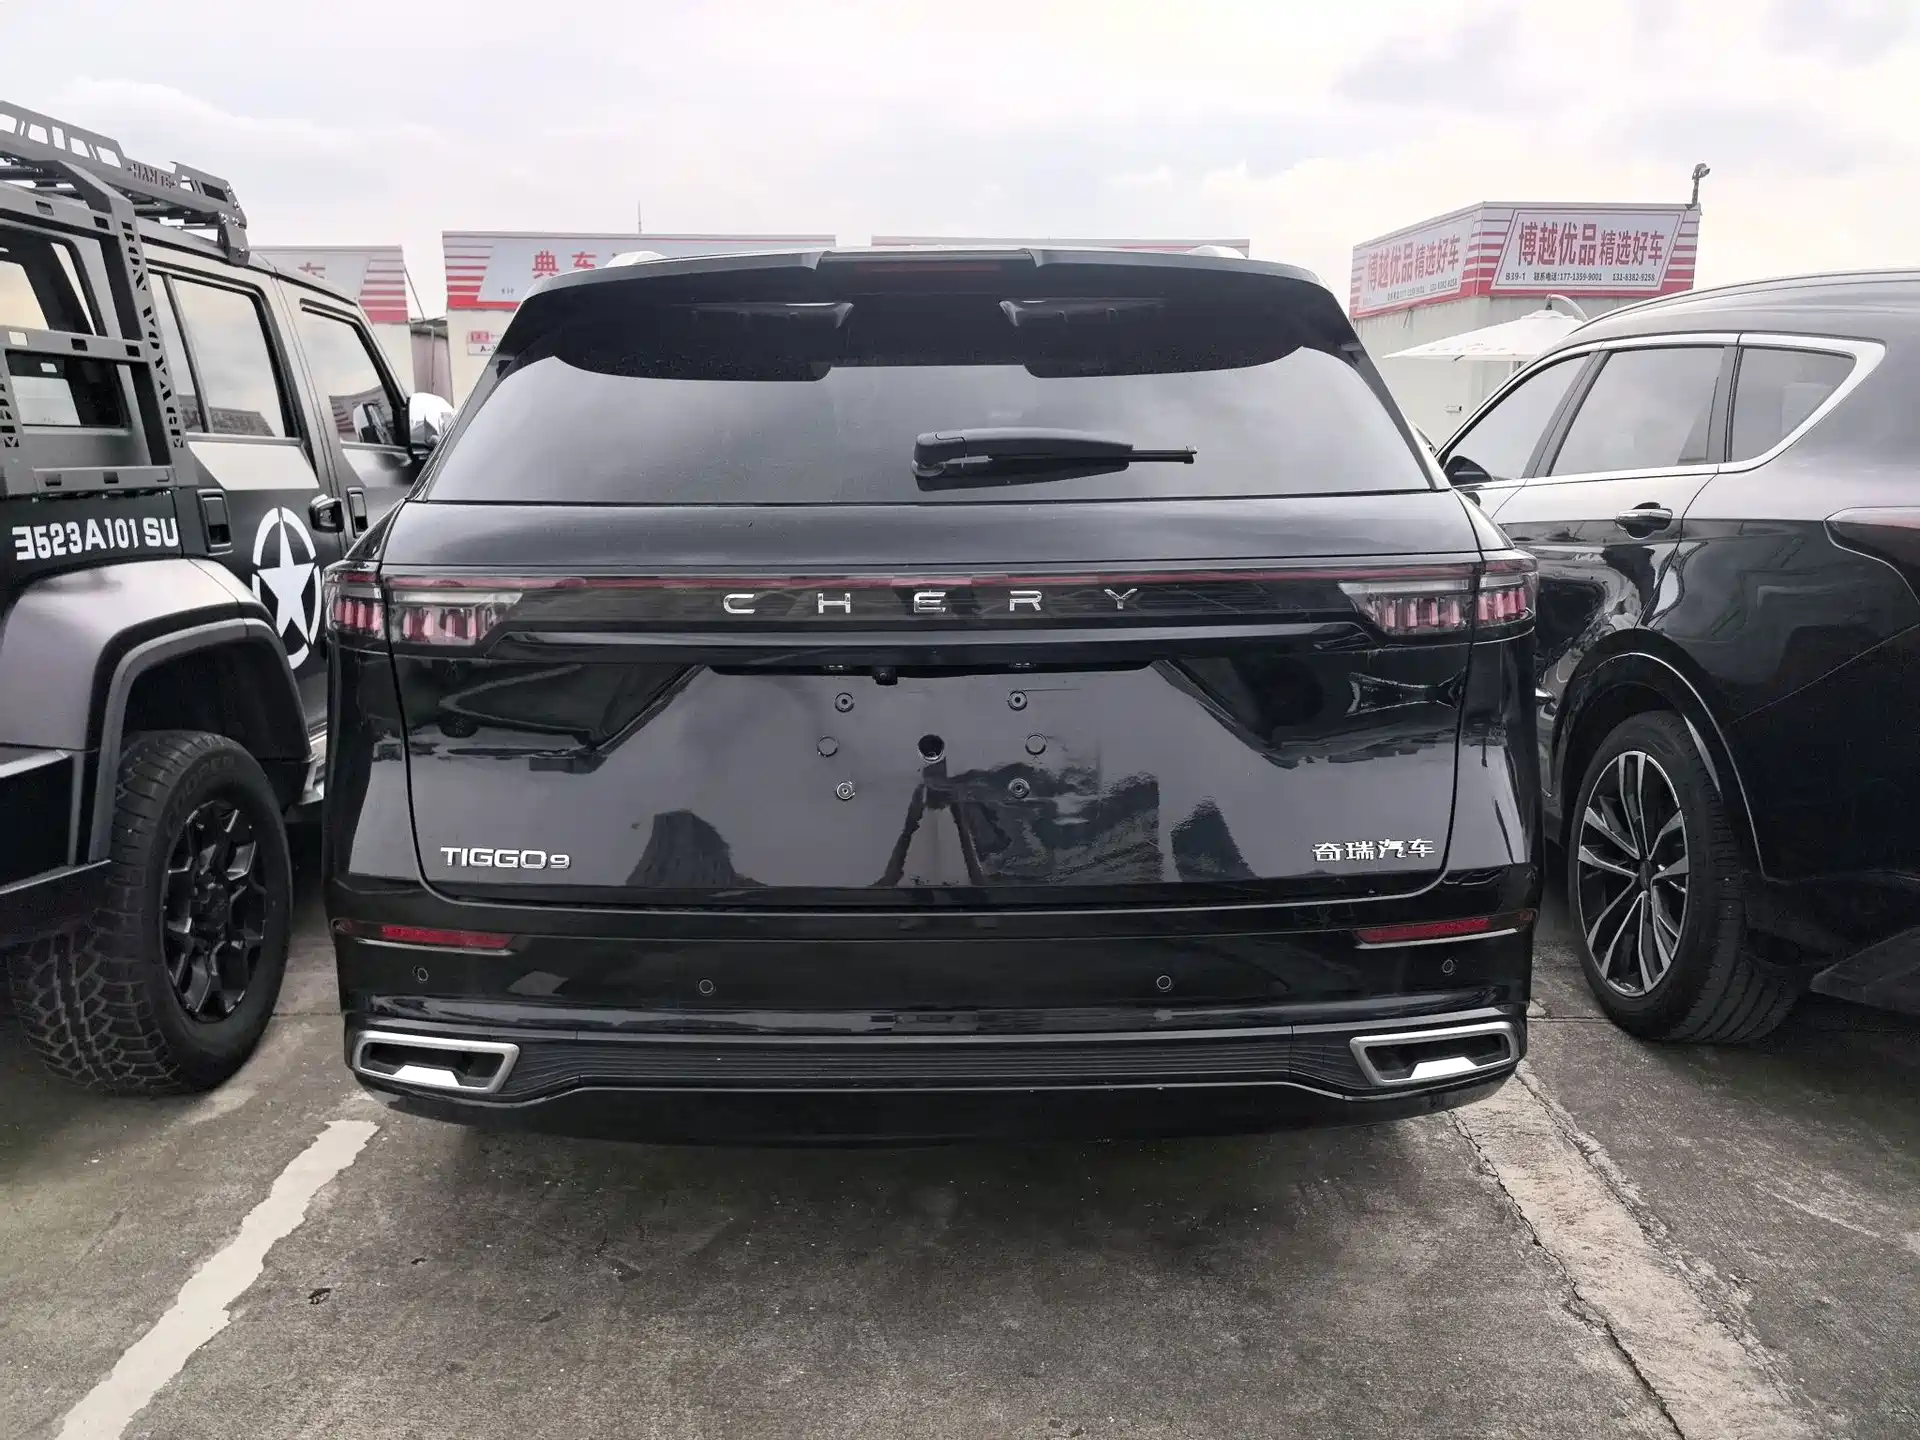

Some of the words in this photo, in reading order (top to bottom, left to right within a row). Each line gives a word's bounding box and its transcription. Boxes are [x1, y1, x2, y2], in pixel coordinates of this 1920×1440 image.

[142, 517, 179, 547] SU
[722, 587, 1139, 616] CHERY
[440, 846, 547, 869] TIGGO
[1311, 838, 1435, 862] 奇瑞汽车
